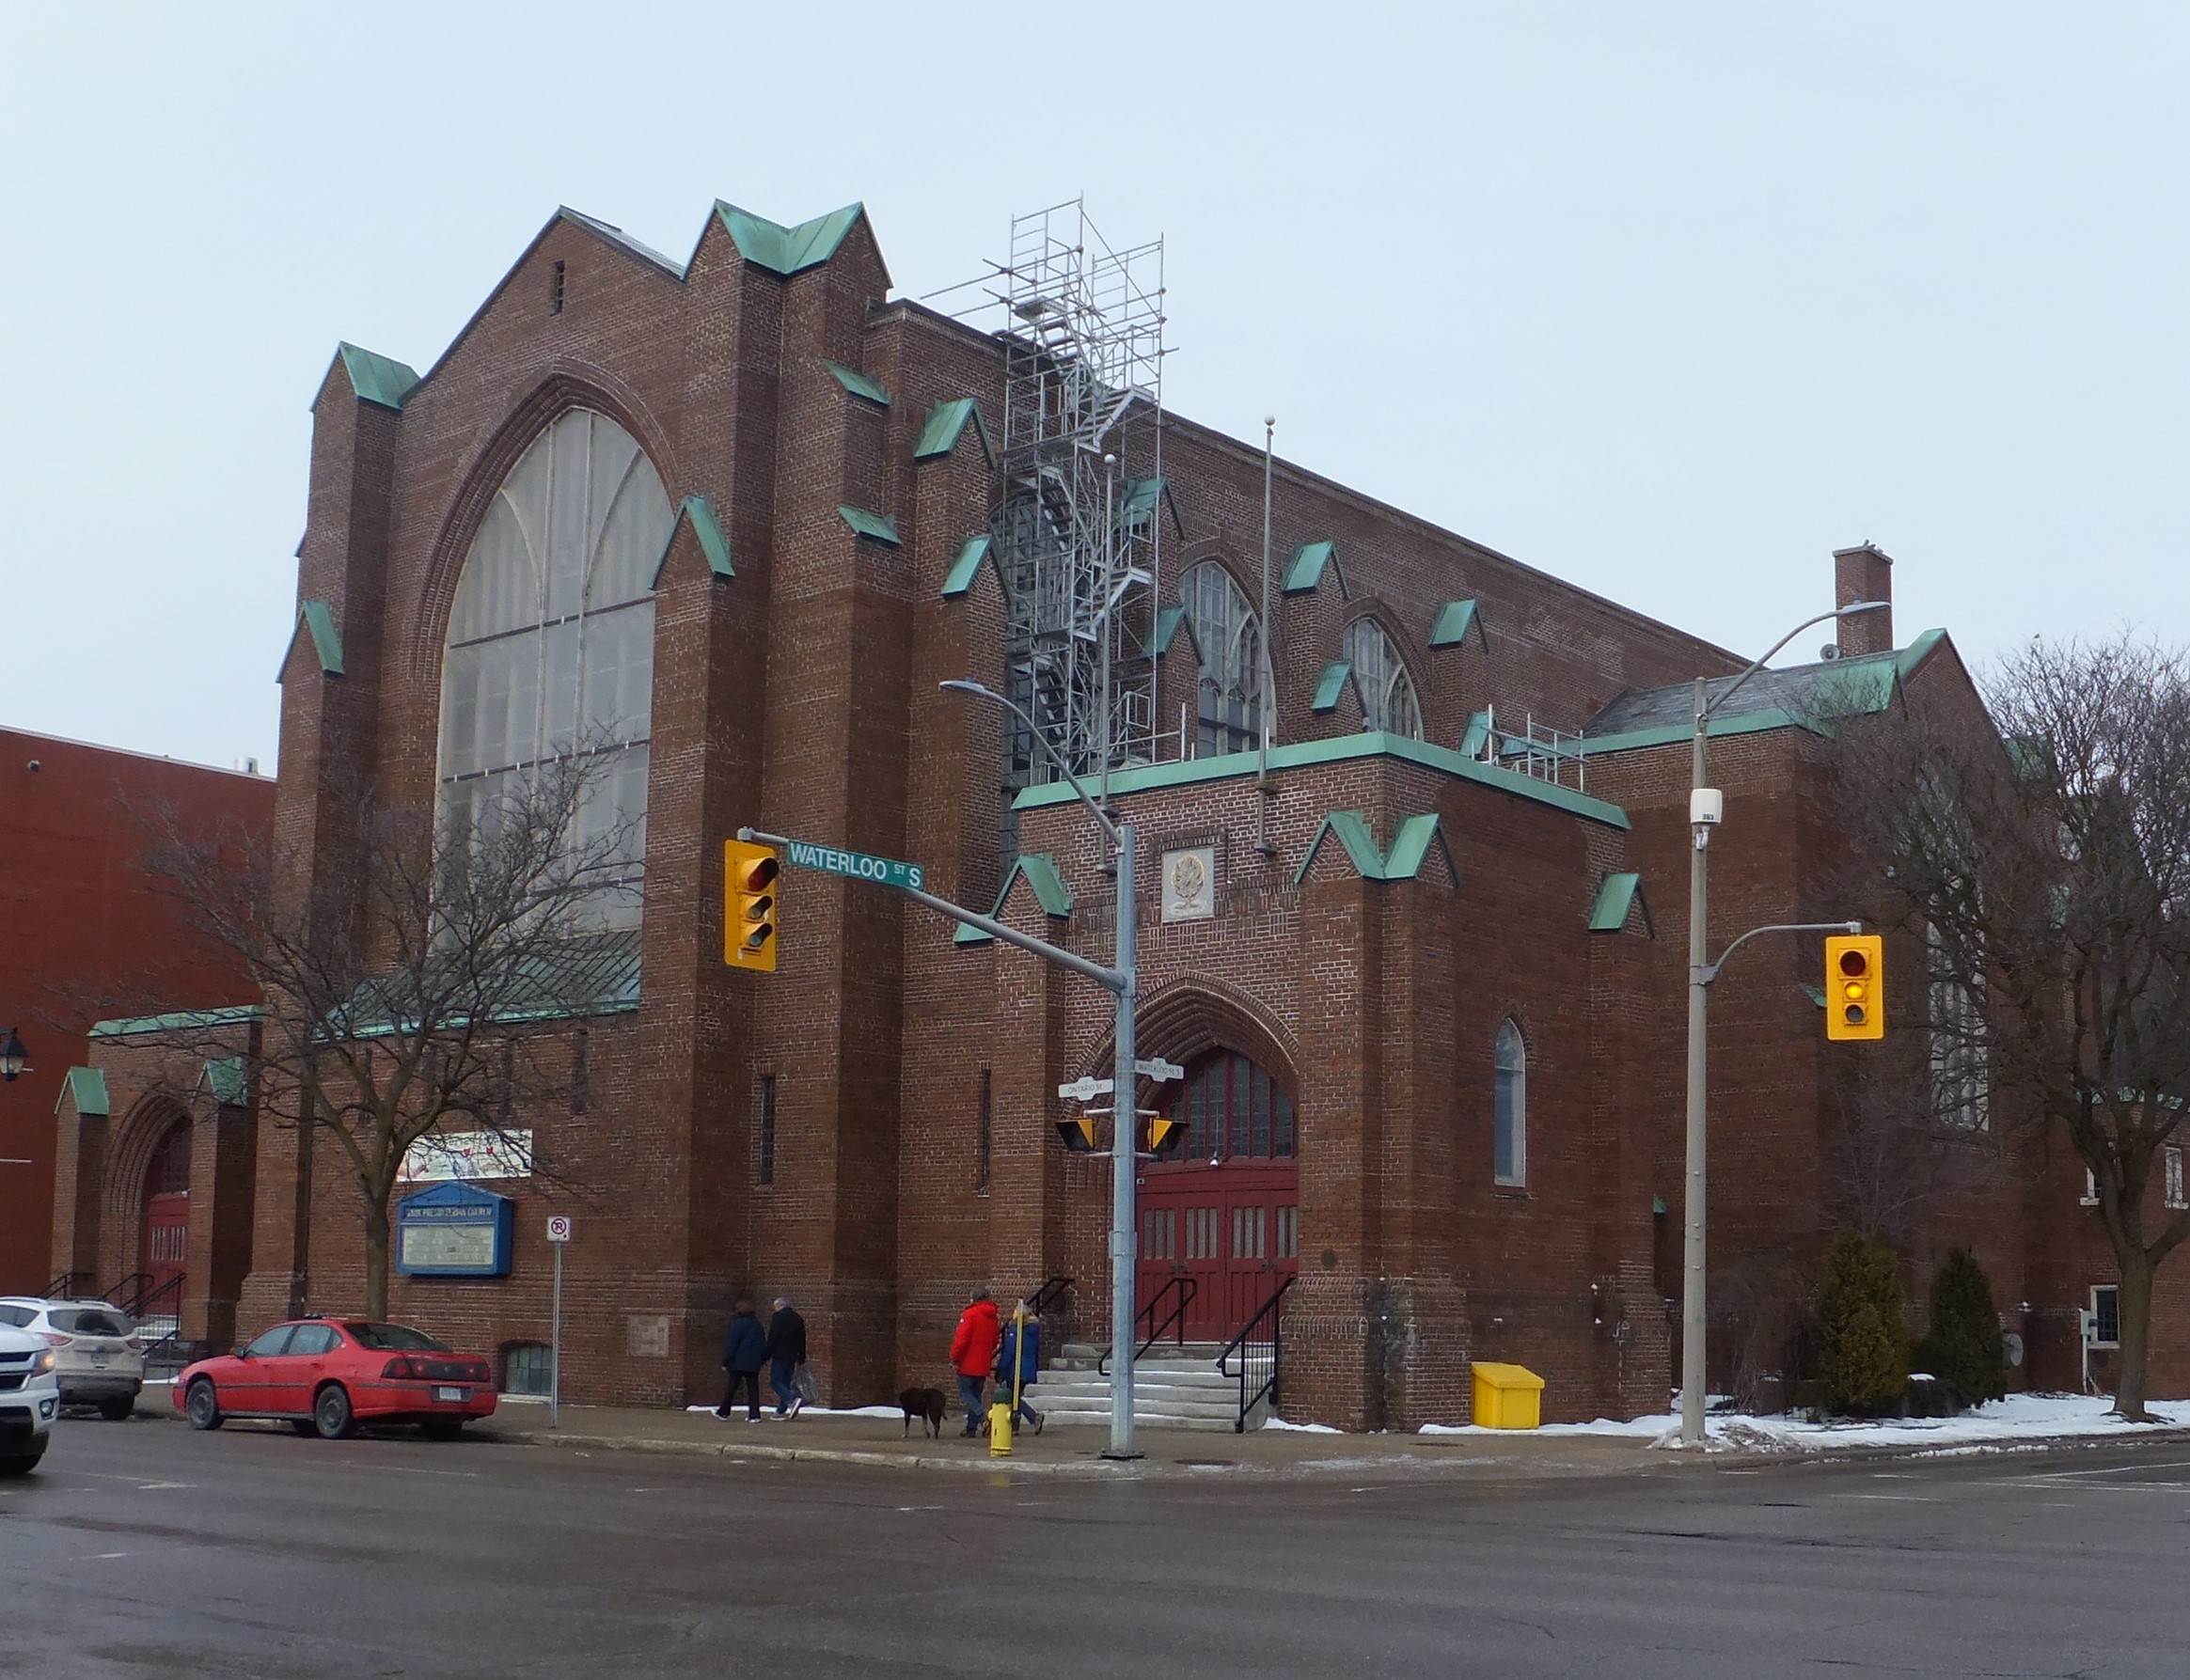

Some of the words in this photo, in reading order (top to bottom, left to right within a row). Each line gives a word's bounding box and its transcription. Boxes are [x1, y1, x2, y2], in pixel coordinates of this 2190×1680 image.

[790, 842, 887, 880] WATERLOO
[894, 864, 906, 875] ST
[908, 867, 921, 887] S
[1068, 1083, 1095, 1094] ONTARIO
